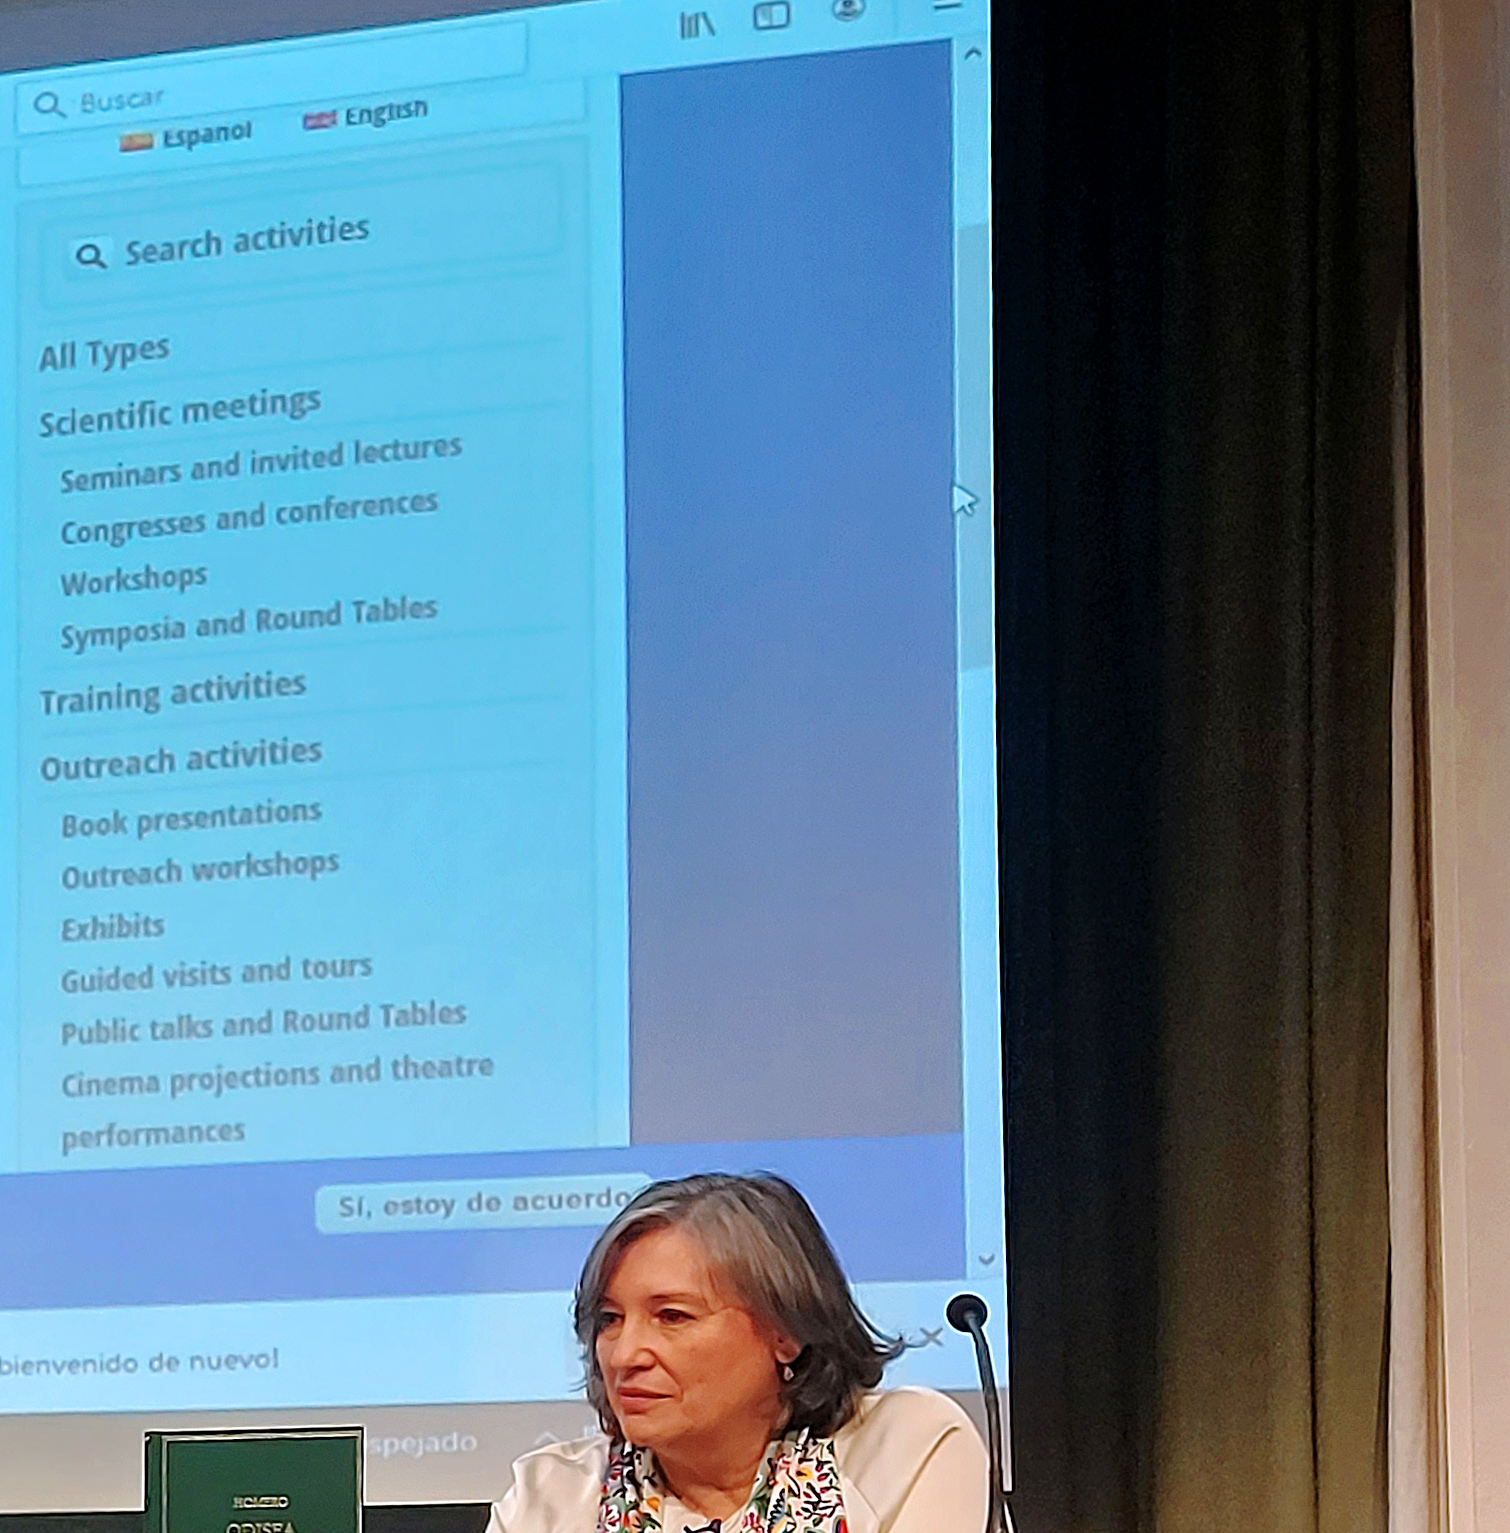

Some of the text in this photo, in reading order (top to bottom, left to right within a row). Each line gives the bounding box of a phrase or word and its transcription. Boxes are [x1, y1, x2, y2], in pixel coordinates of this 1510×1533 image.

[81, 87, 166, 115] Buscar
[125, 214, 370, 268] Search activities
[38, 336, 170, 374] All Types
[38, 387, 321, 439] Scientific meetings
[60, 435, 463, 496] Seminars and invited lectures
[60, 491, 439, 550] Congresses and conferences
[60, 562, 208, 598] Workshops
[60, 593, 439, 657] Symposia and Round Tables
[38, 668, 308, 717] Training activities
[40, 735, 323, 783] Outreach activities
[61, 796, 323, 842] Book presentations
[61, 849, 340, 892] Outreach workshops
[61, 910, 165, 944] Exhibits
[61, 953, 374, 995] Guided visits and tours
[61, 997, 468, 1048] Public talks and Round Tables
[61, 1053, 495, 1101] Cinema projections and theatre
[61, 1120, 246, 1158] performances
[383, 1195, 456, 1221] estoy
[466, 1190, 502, 1214] de
[511, 1186, 633, 1213] acuerdo
